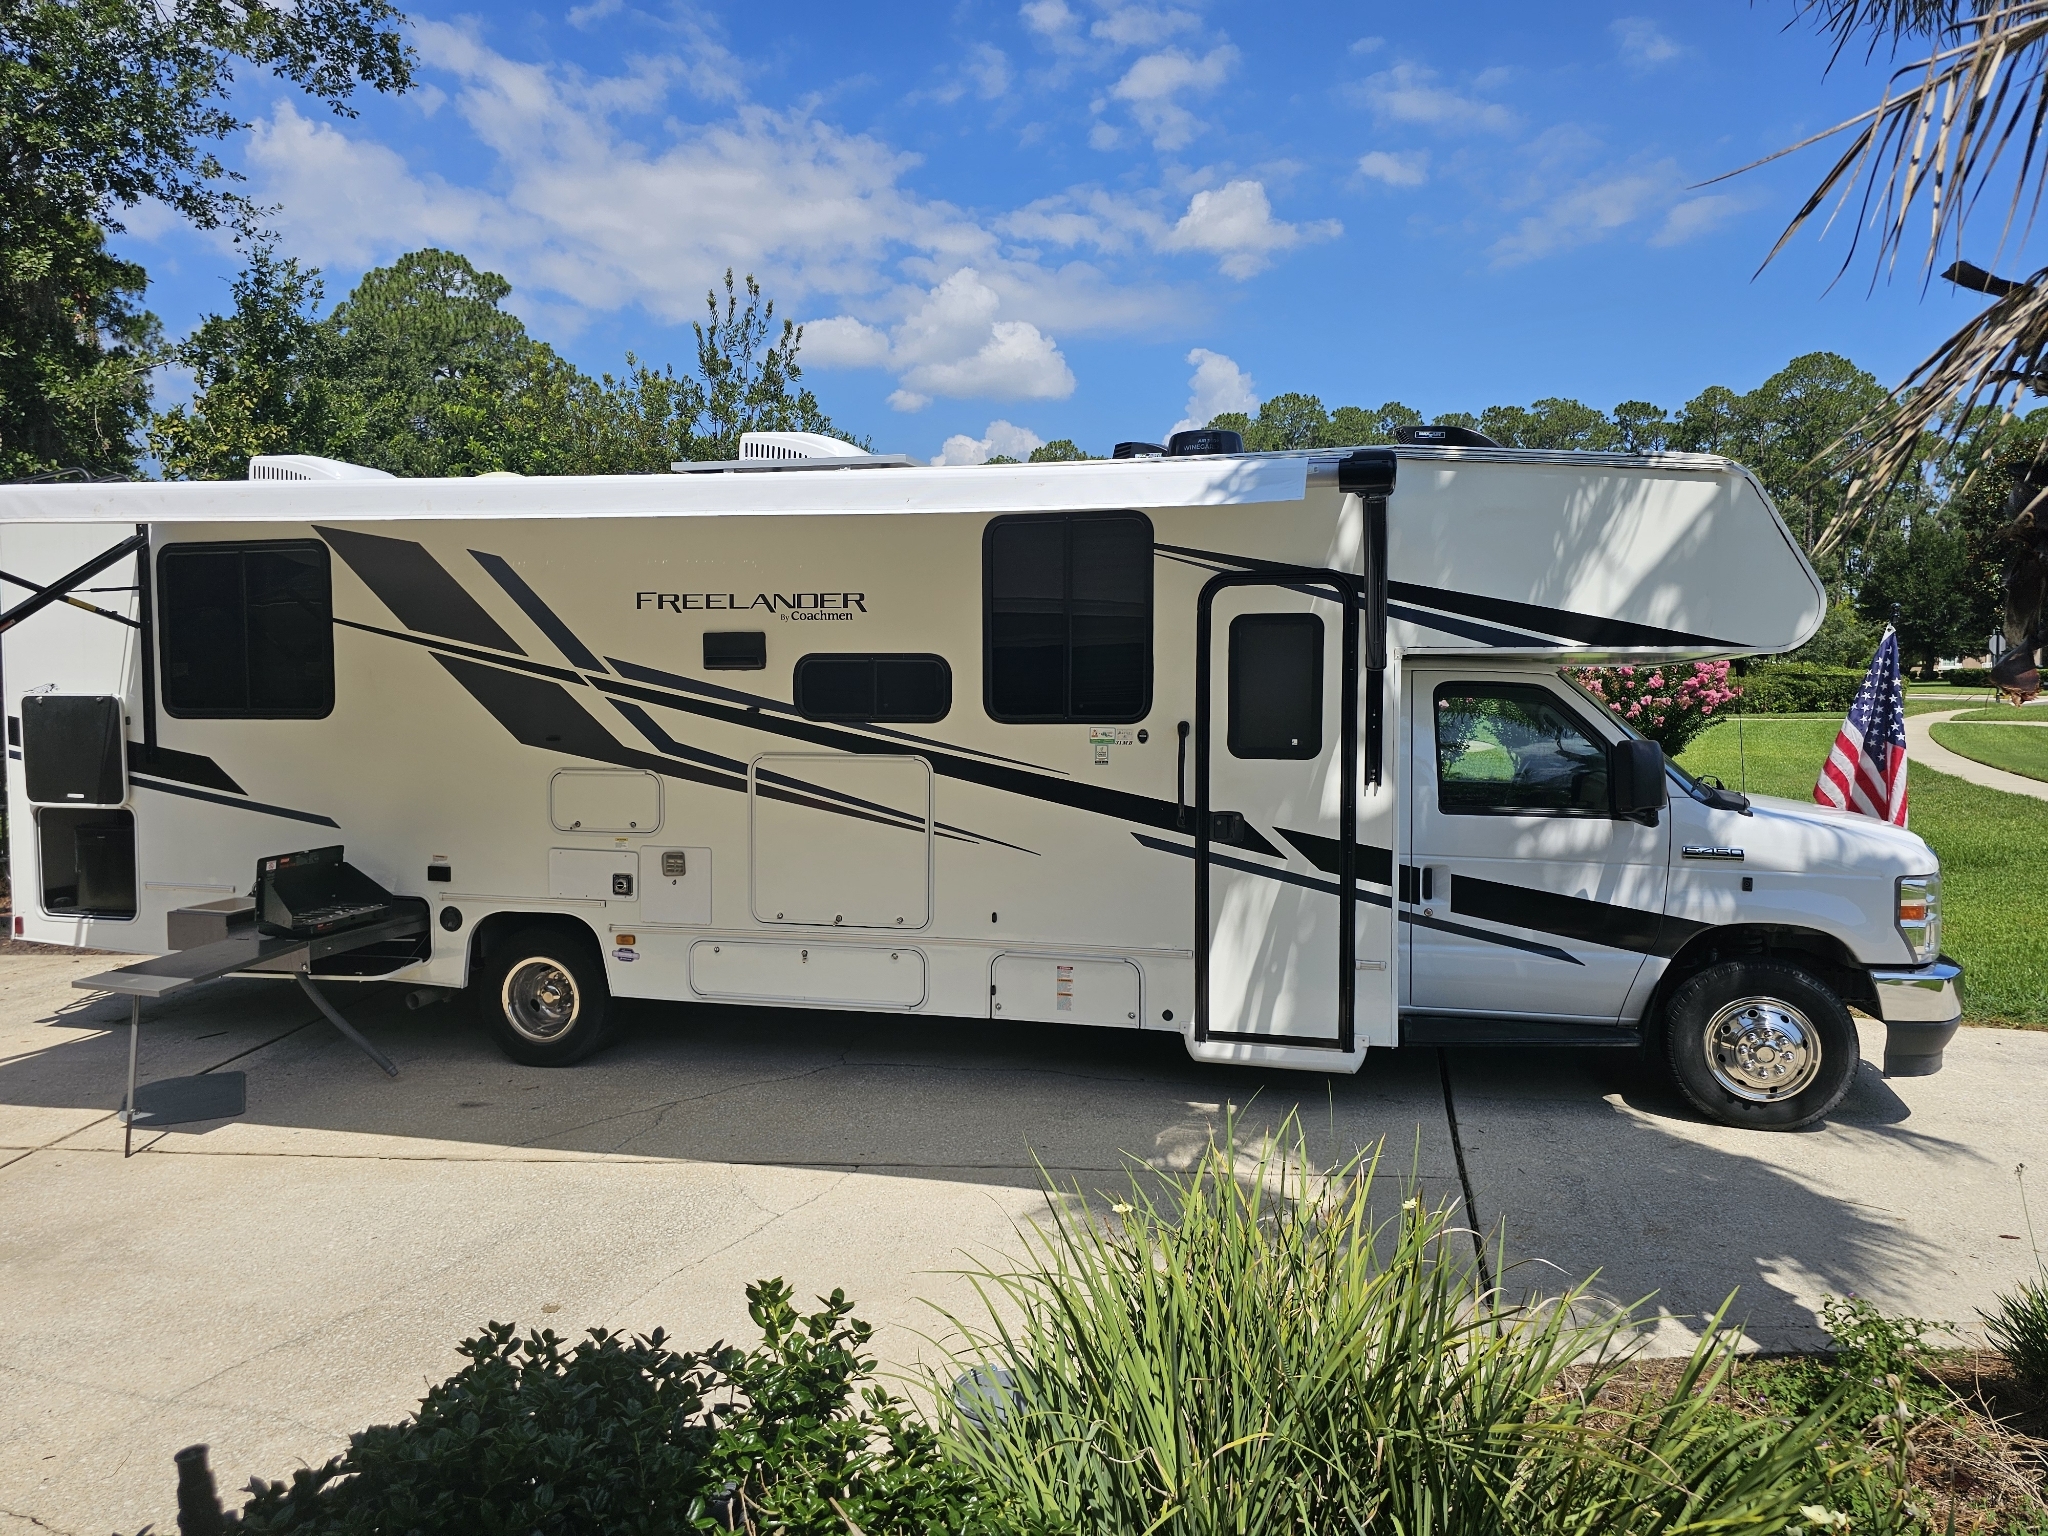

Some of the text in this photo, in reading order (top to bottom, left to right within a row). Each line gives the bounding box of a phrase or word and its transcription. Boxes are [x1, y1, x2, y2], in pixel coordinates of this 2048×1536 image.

[636, 592, 868, 614] FREELANDER
[780, 610, 854, 623] By Coachmen
